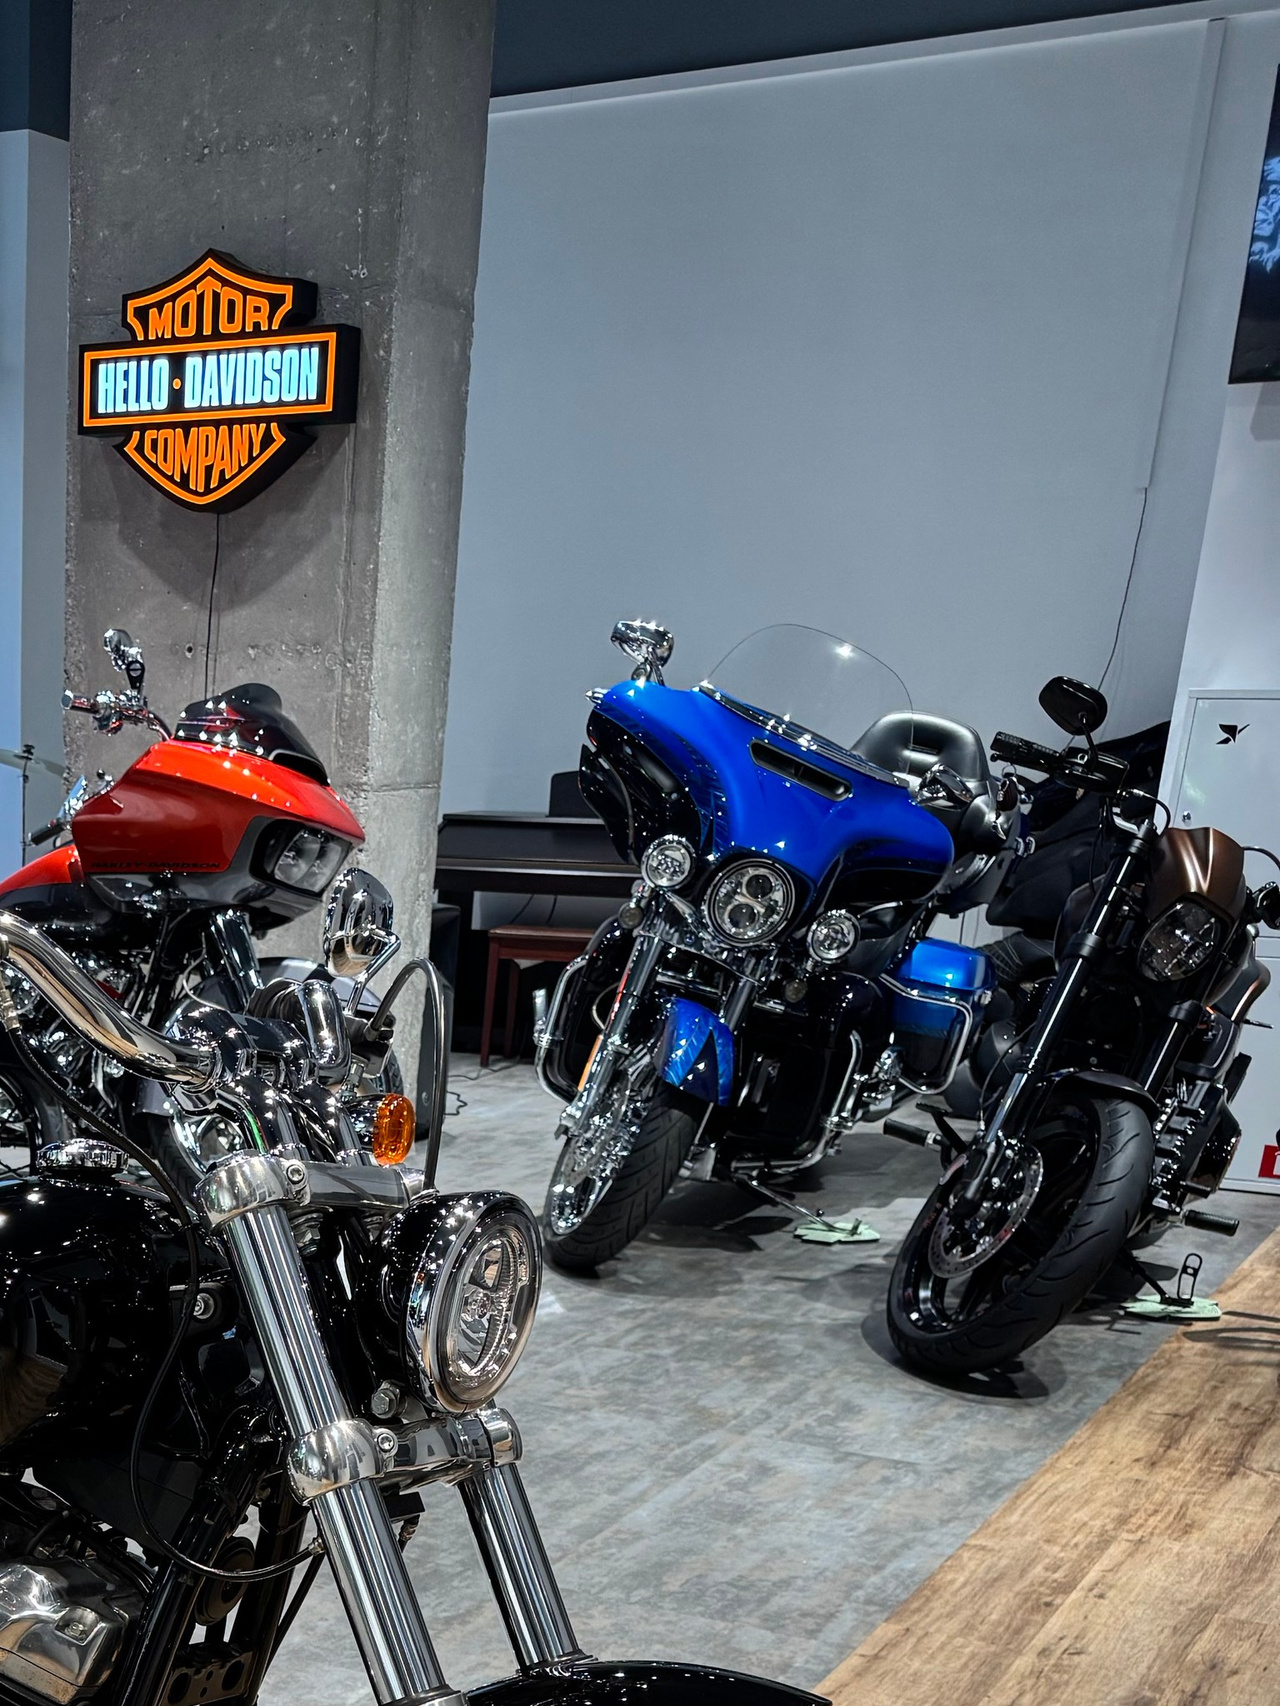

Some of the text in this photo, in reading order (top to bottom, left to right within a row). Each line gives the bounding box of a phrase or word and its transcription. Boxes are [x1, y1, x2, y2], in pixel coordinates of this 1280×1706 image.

[148, 275, 270, 340] MOTOR
[97, 347, 319, 414] HELLO DAVIDSON
[144, 423, 267, 492] COMPANY
